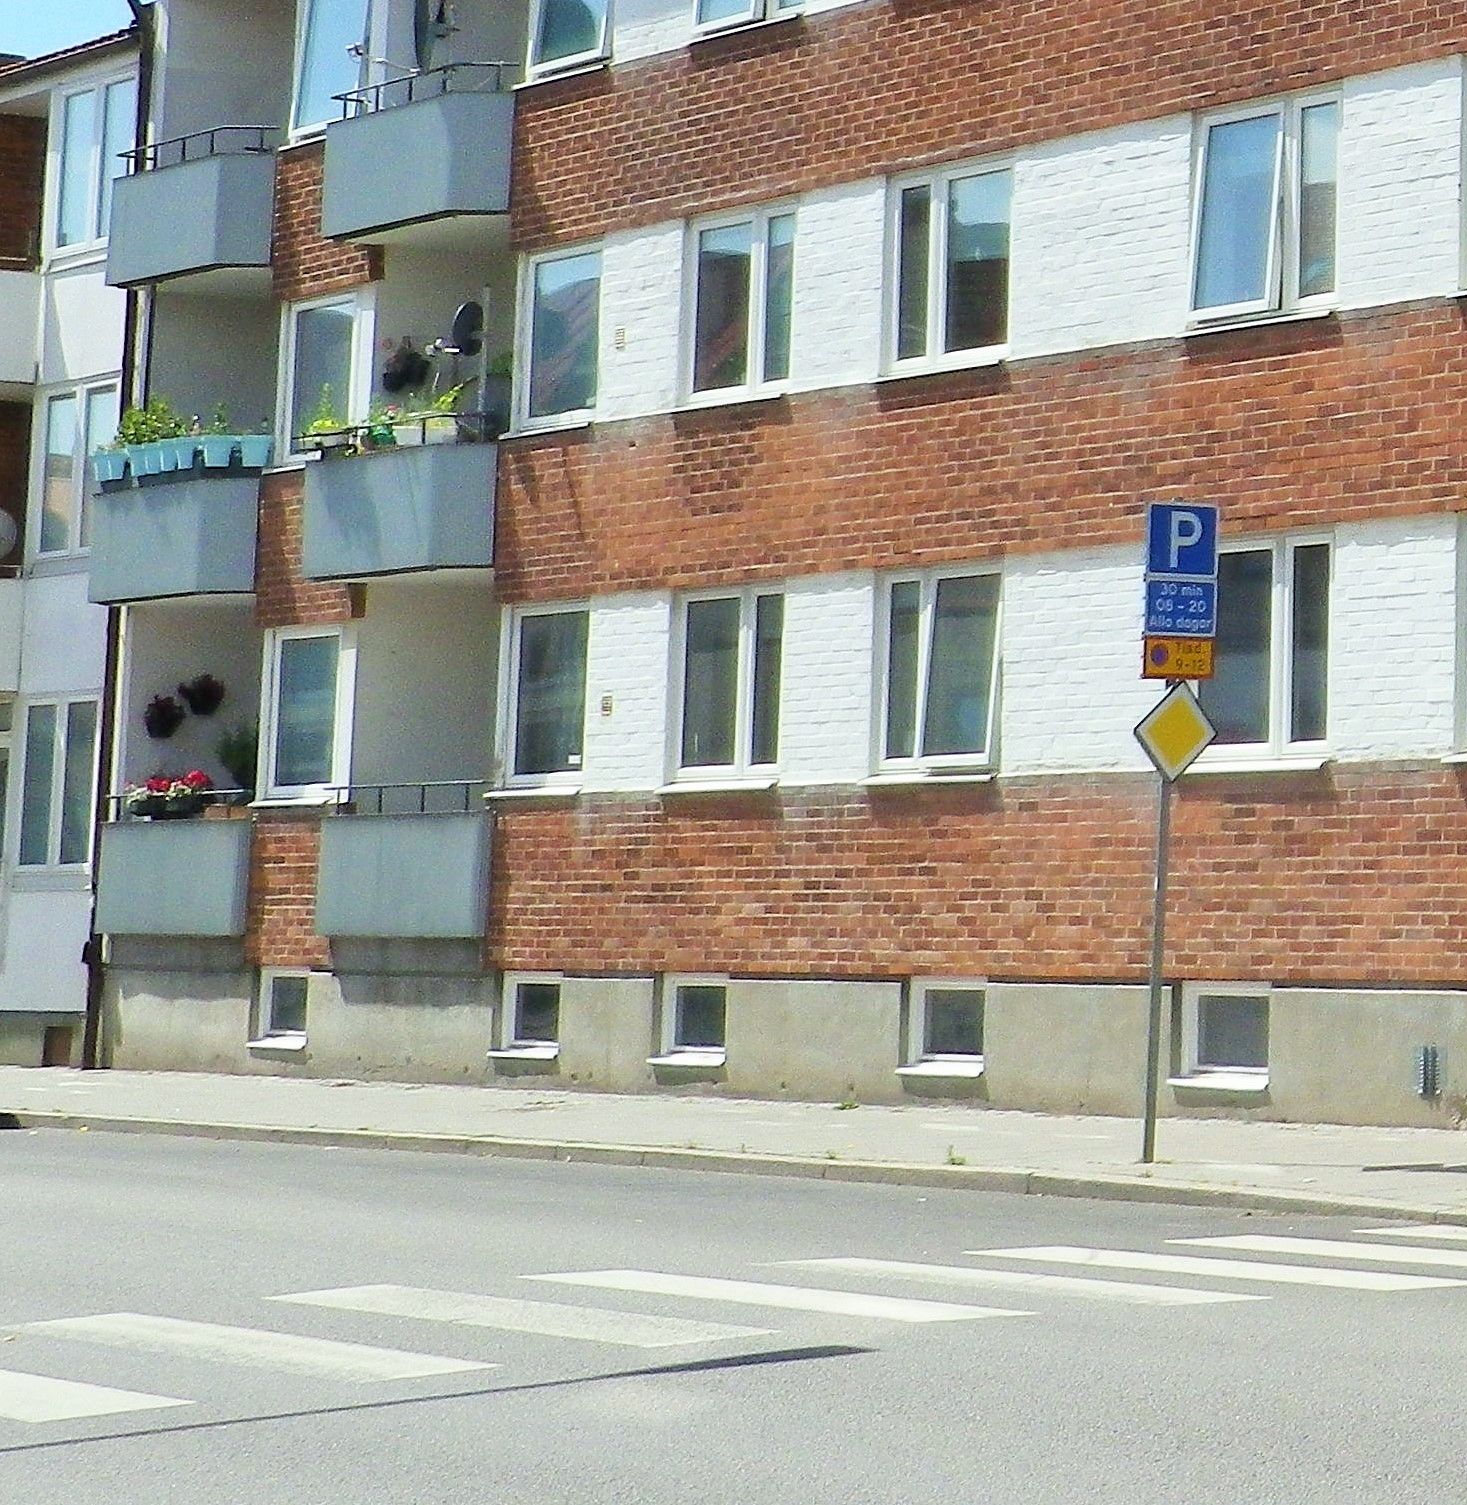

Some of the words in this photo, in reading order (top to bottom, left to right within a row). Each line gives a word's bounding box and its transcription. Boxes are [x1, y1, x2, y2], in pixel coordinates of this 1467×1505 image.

[1169, 511, 1203, 568] P
[1160, 582, 1178, 596] 30
[1181, 584, 1204, 596] min
[1188, 600, 1207, 613] 20
[1149, 615, 1173, 628] Alla
[1176, 617, 1213, 631] dagar
